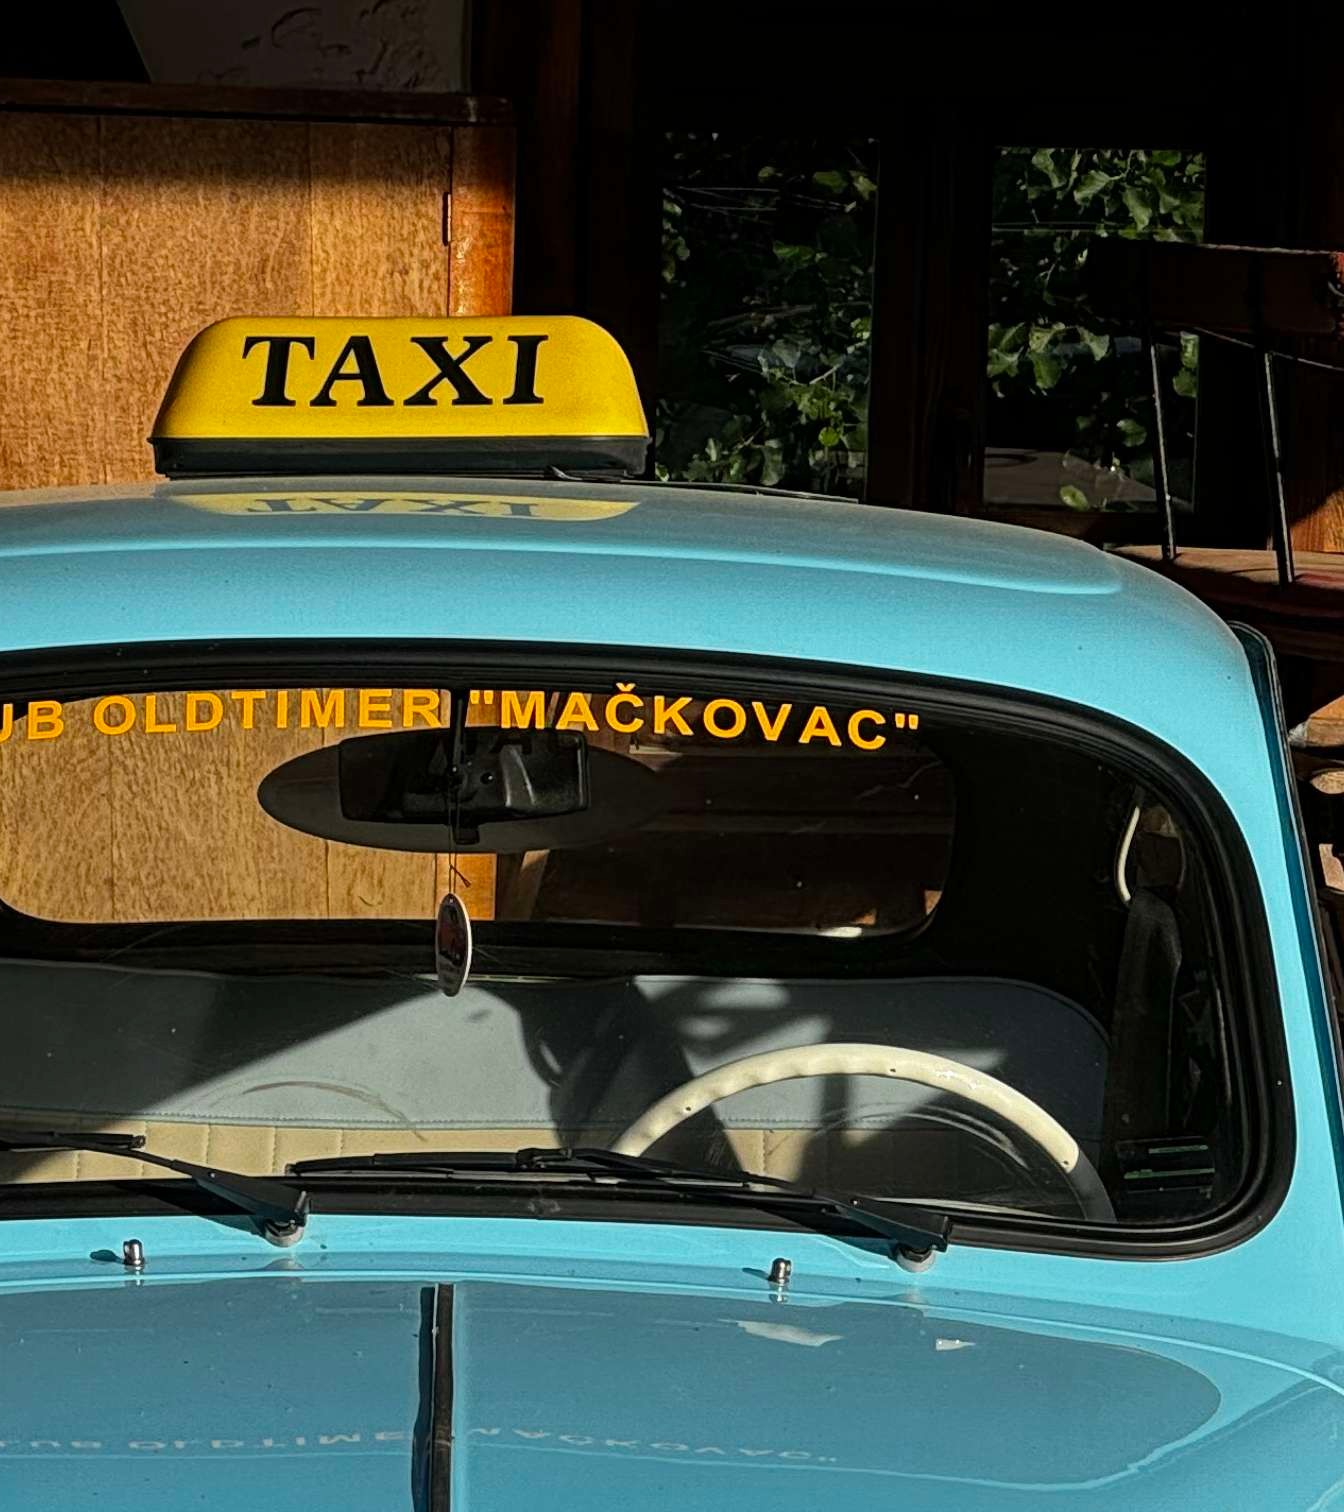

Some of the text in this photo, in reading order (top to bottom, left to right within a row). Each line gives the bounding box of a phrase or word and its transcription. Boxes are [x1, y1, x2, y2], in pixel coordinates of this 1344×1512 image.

[242, 335, 549, 407] TAXI
[92, 687, 442, 736] OLDTIMER
[469, 682, 920, 750] "MAČKOVAC"
